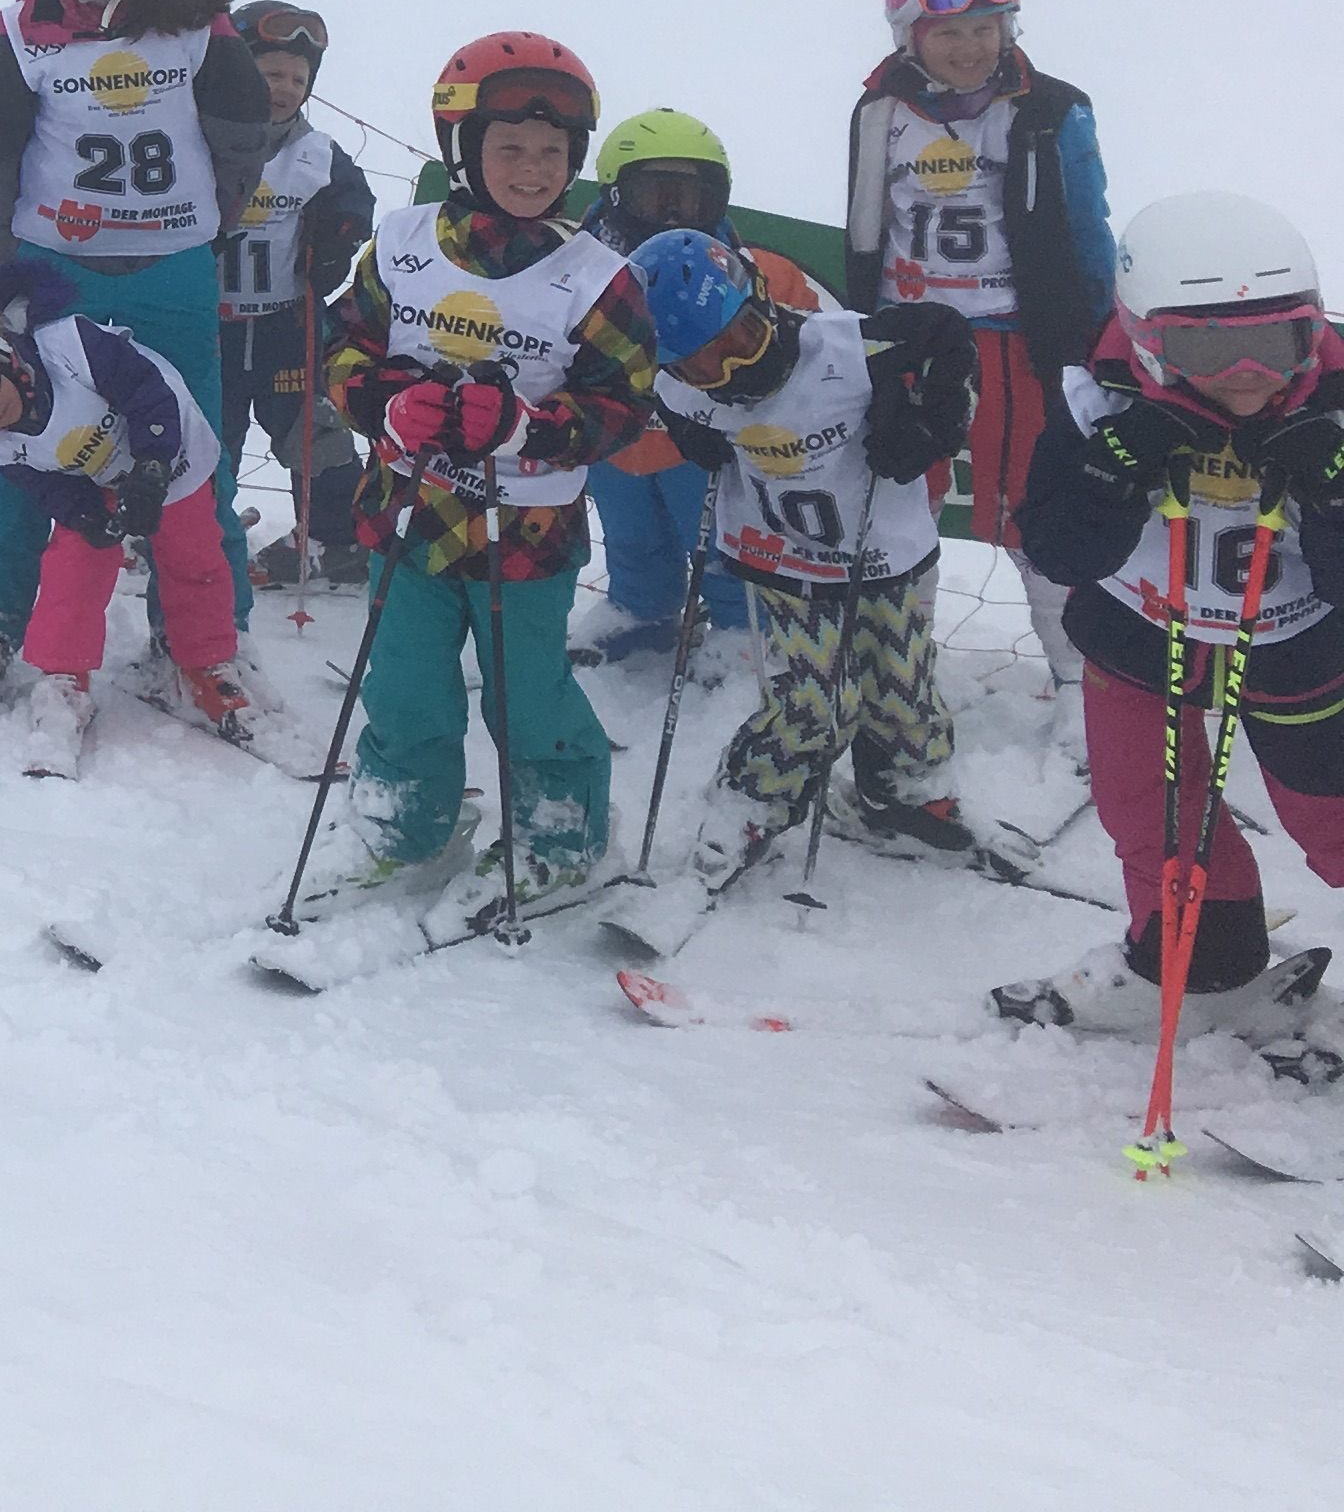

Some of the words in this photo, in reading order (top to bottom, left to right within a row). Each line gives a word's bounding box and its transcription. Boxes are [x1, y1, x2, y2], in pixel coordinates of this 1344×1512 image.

[53, 67, 188, 94] SONNENKOPF
[73, 129, 177, 196] 28
[111, 207, 138, 220] DER
[141, 201, 197, 220] MONTAGE-
[163, 214, 198, 230] PROFI
[907, 201, 989, 263] 15
[223, 240, 272, 294] 11
[981, 277, 1012, 289] PRO
[239, 303, 259, 314] DER
[696, 274, 715, 307] uvex
[392, 303, 553, 357] SONNENKOPF
[1104, 427, 1138, 467] LEKI
[432, 458, 510, 499] MONTAE-
[748, 474, 845, 549] 10
[816, 546, 889, 566] MONAGE-
[1200, 607, 1238, 622] DER
[1254, 591, 1320, 620] ONTAG
[1171, 620, 1185, 696] LEKI
[665, 674, 684, 735] HEAD
